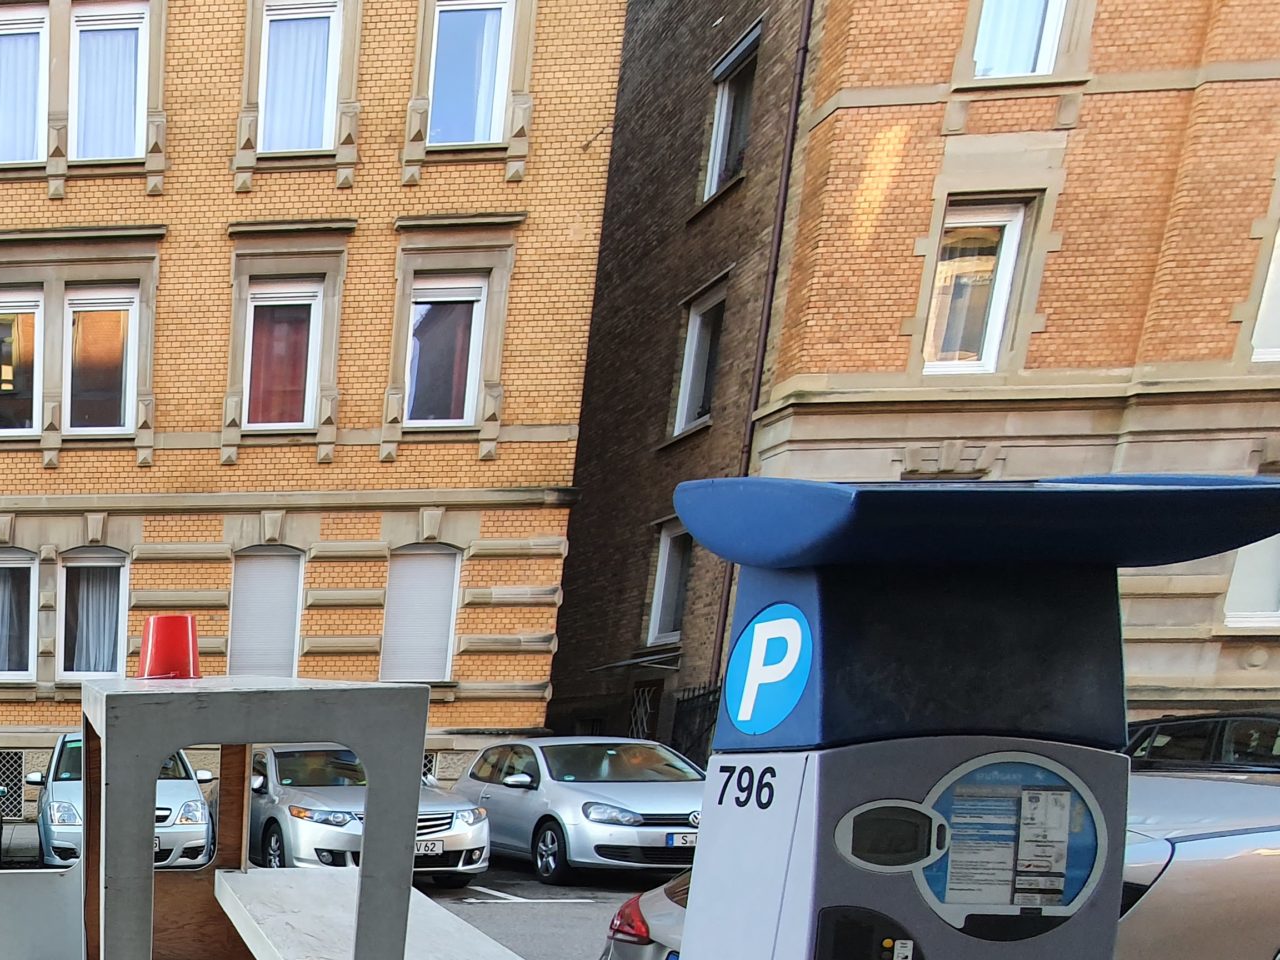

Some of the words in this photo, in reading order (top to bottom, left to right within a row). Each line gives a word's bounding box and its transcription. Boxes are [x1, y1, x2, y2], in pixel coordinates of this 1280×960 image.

[737, 618, 802, 721] P
[717, 765, 777, 810] 796
[423, 842, 437, 852] 62
